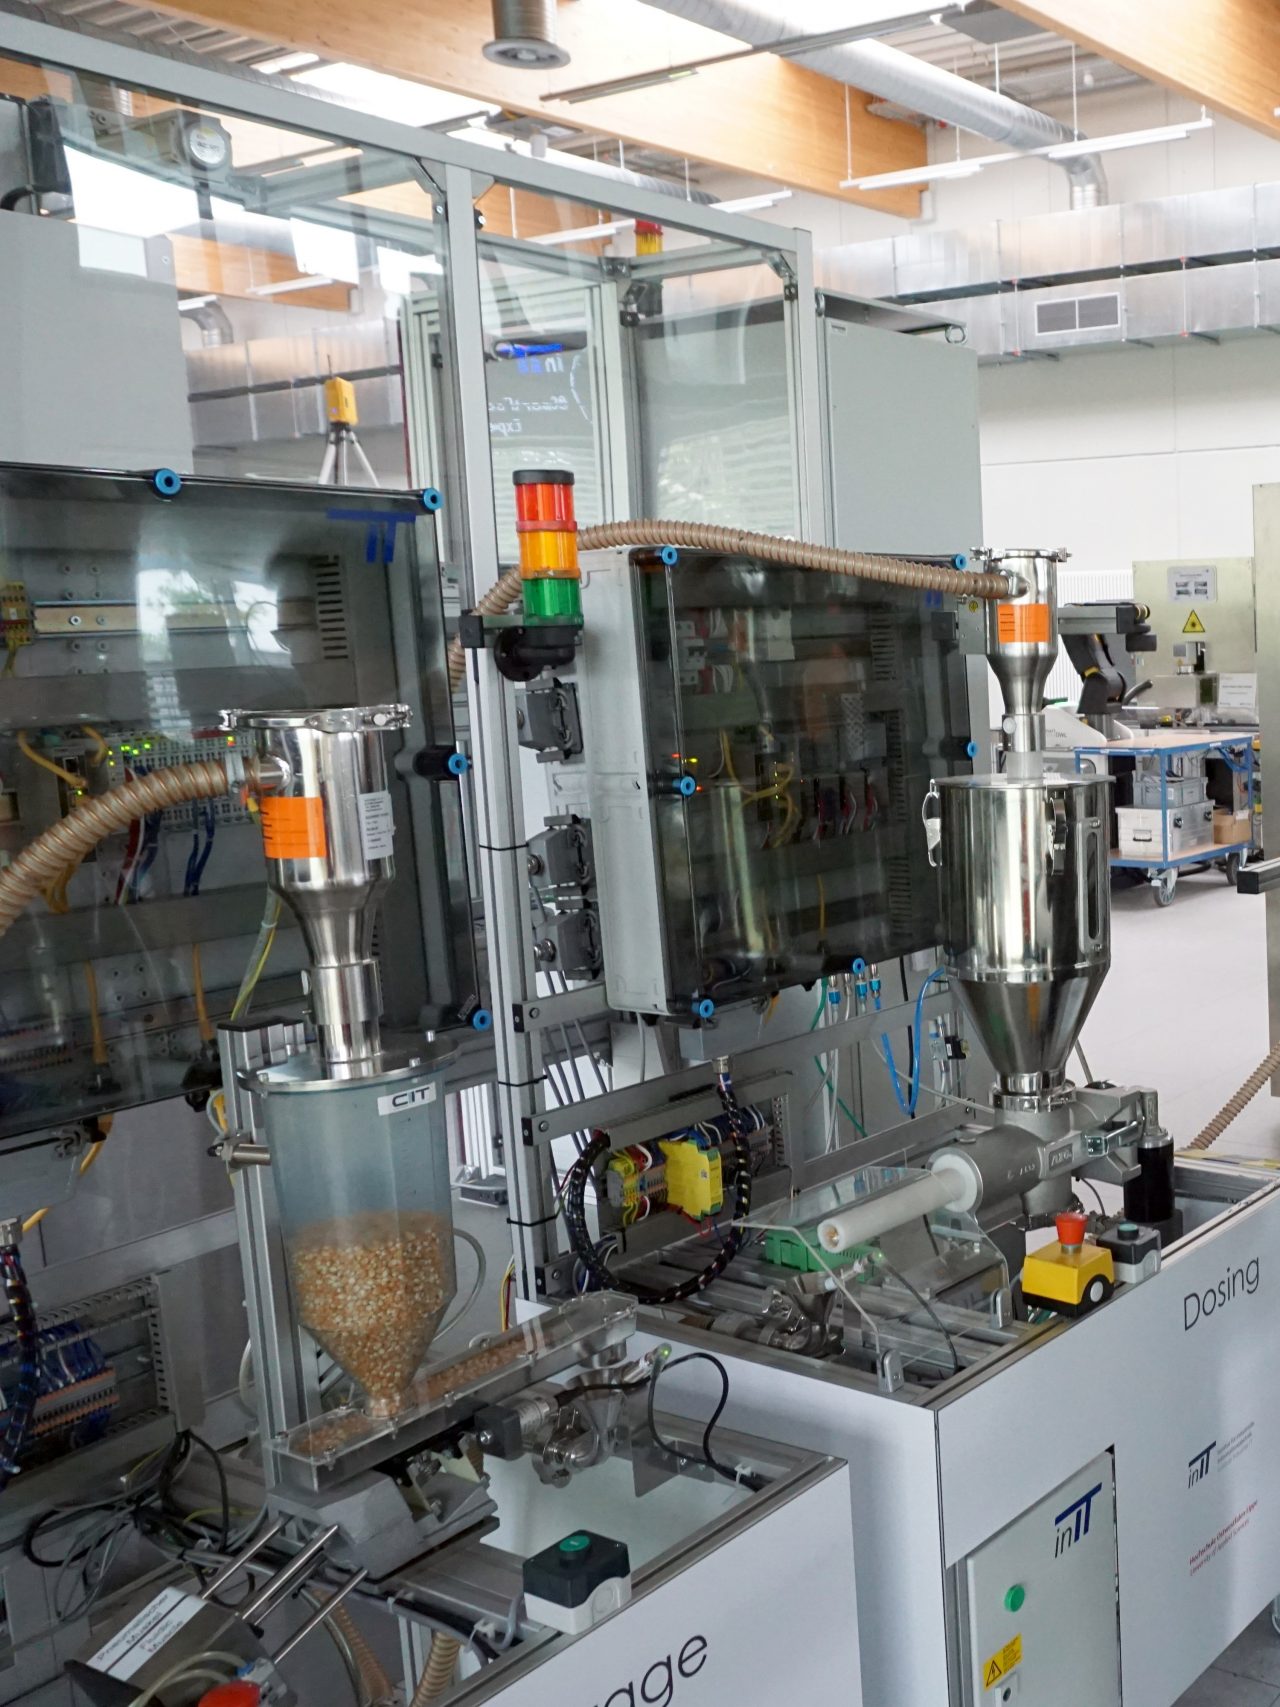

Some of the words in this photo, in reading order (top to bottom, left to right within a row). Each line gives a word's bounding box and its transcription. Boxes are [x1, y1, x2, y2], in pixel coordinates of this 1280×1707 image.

[392, 1086, 430, 1107] CIT
[1184, 1256, 1260, 1331] Dosing
[1054, 1481, 1103, 1558] inIT
[603, 1634, 708, 1707] age
